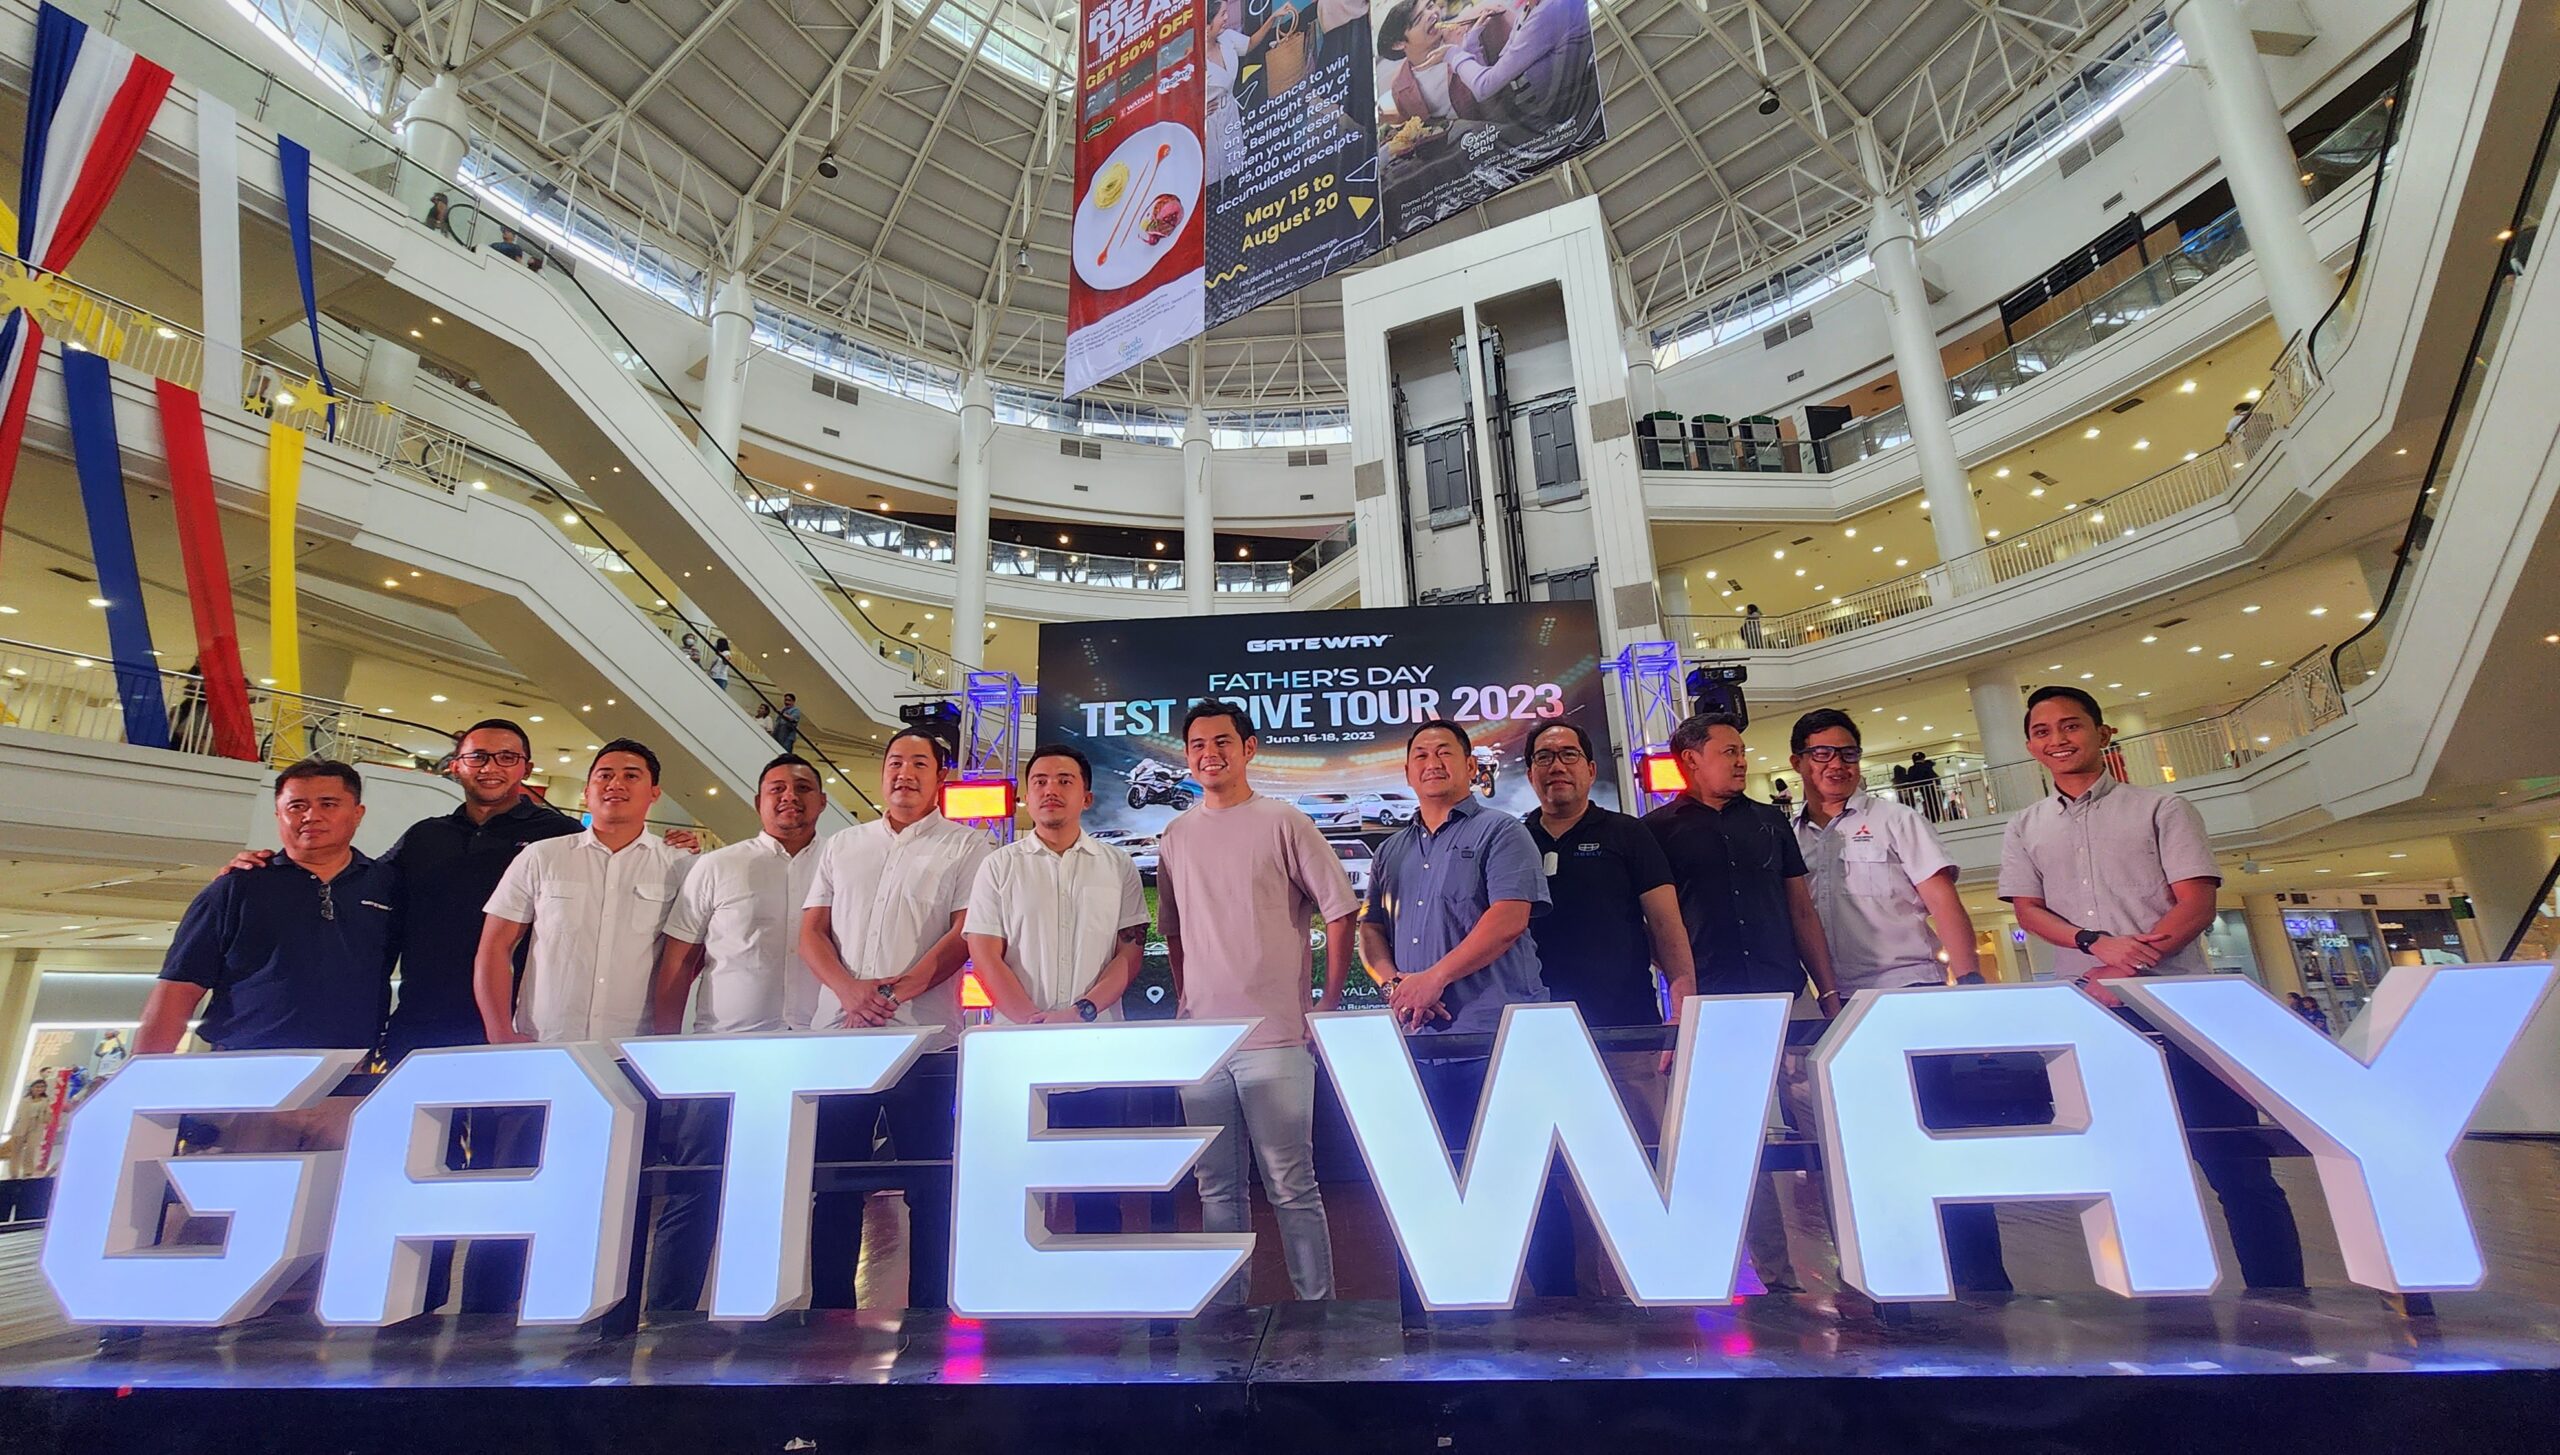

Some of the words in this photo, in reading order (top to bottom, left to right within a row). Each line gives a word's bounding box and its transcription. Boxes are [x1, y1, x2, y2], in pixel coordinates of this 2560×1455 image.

[1086, 60, 1116, 90] GET
[1120, 35, 1155, 68] 50%
[1159, 8, 1194, 40] OFF
[1100, 0, 1181, 55] DEA
[1103, 45, 1118, 61] BPI
[1120, 20, 1156, 48] CREDIT
[1224, 116, 1246, 134] Get
[1248, 110, 1256, 120] a
[1259, 80, 1306, 114] chance
[1310, 70, 1323, 84] to
[1326, 54, 1349, 74] win
[1224, 136, 1240, 150] an
[1242, 98, 1302, 140] overnight
[1305, 79, 1334, 102] stay
[1338, 68, 1350, 84] at
[1226, 146, 1248, 163] The
[1250, 113, 1304, 150] Bellevue
[1307, 85, 1349, 118] Resort
[1230, 151, 1264, 176] when
[1266, 136, 1290, 158] you
[1294, 104, 1344, 144] present
[1282, 136, 1320, 162] worth
[1324, 124, 1338, 140] of
[1468, 130, 1500, 152] center
[1469, 142, 1494, 160] cebu
[1216, 160, 1300, 214] accumulated
[1304, 131, 1362, 166] receipts.
[1401, 197, 1420, 210] Promo
[1422, 190, 1434, 200] runs
[1434, 182, 1448, 192] from
[1484, 154, 1500, 166] 2023
[1502, 152, 1509, 160] to
[1509, 135, 1545, 156] December
[1412, 204, 1422, 214] DTI
[1434, 190, 1452, 202] Trade
[1560, 127, 1578, 140] 2023
[1242, 208, 1311, 253] August
[1315, 192, 1338, 216] 20
[1245, 197, 1286, 228] May
[1290, 185, 1309, 204] 15
[1314, 173, 1334, 192] to
[1257, 280, 1275, 292] Permit
[1342, 246, 1349, 254] of
[1274, 260, 1288, 272] visit
[1289, 256, 1300, 265] the
[1302, 238, 1340, 259] Concierge.
[1246, 634, 1388, 652] GATEWAY
[1209, 668, 1360, 692] FATHER'S
[1367, 665, 1434, 686] DAY
[1080, 698, 1176, 737] TEST
[1188, 693, 1314, 730] IVE
[1322, 688, 1442, 726] TOUR
[1452, 683, 1564, 722] 2023
[1266, 735, 1300, 744] June
[1302, 733, 1340, 742] 16-18,
[1342, 732, 1376, 740] 2023
[1342, 986, 1378, 997] YALA
[40, 962, 2557, 1327] GATEWAY
